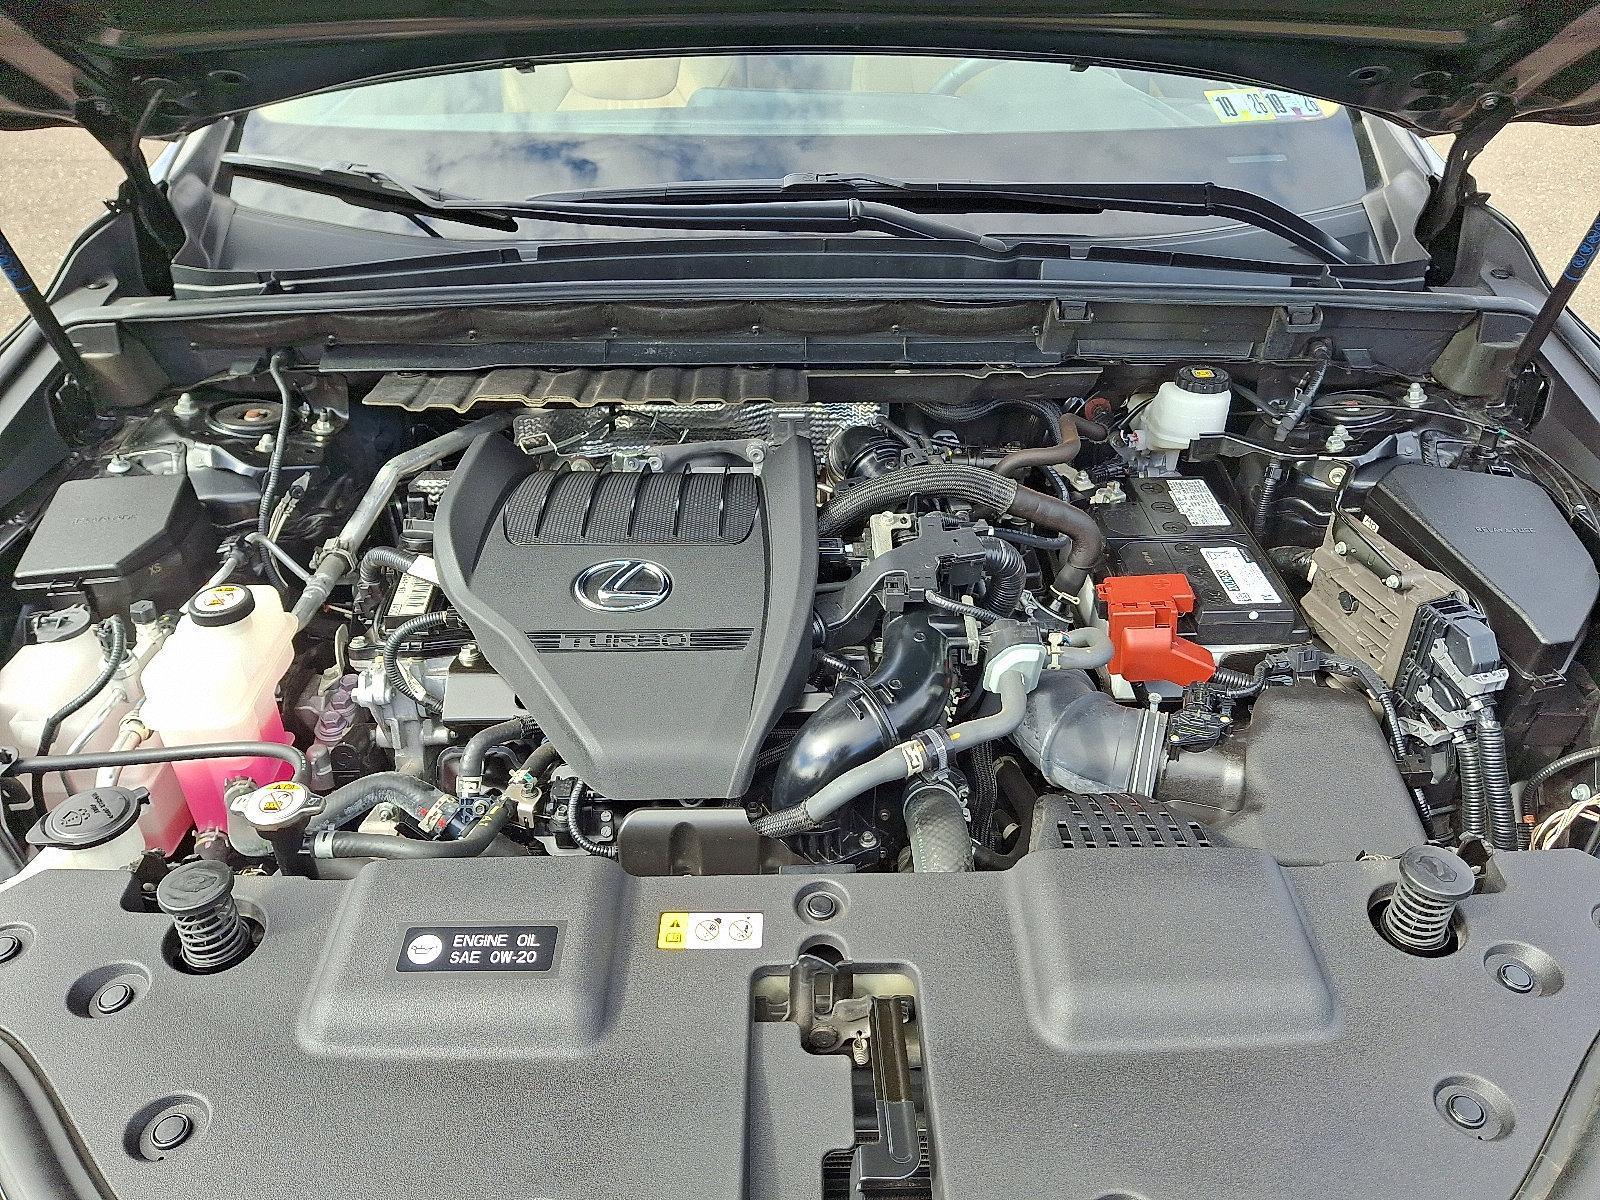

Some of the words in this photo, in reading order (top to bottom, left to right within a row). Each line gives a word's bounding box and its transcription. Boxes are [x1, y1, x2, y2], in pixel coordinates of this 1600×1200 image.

[1246, 93, 1268, 114] 26
[564, 632, 687, 649] TURBO
[452, 934, 509, 948] ENGINE
[516, 934, 541, 947] OIL
[449, 950, 482, 964] SAE
[489, 950, 537, 964] 0W-20
